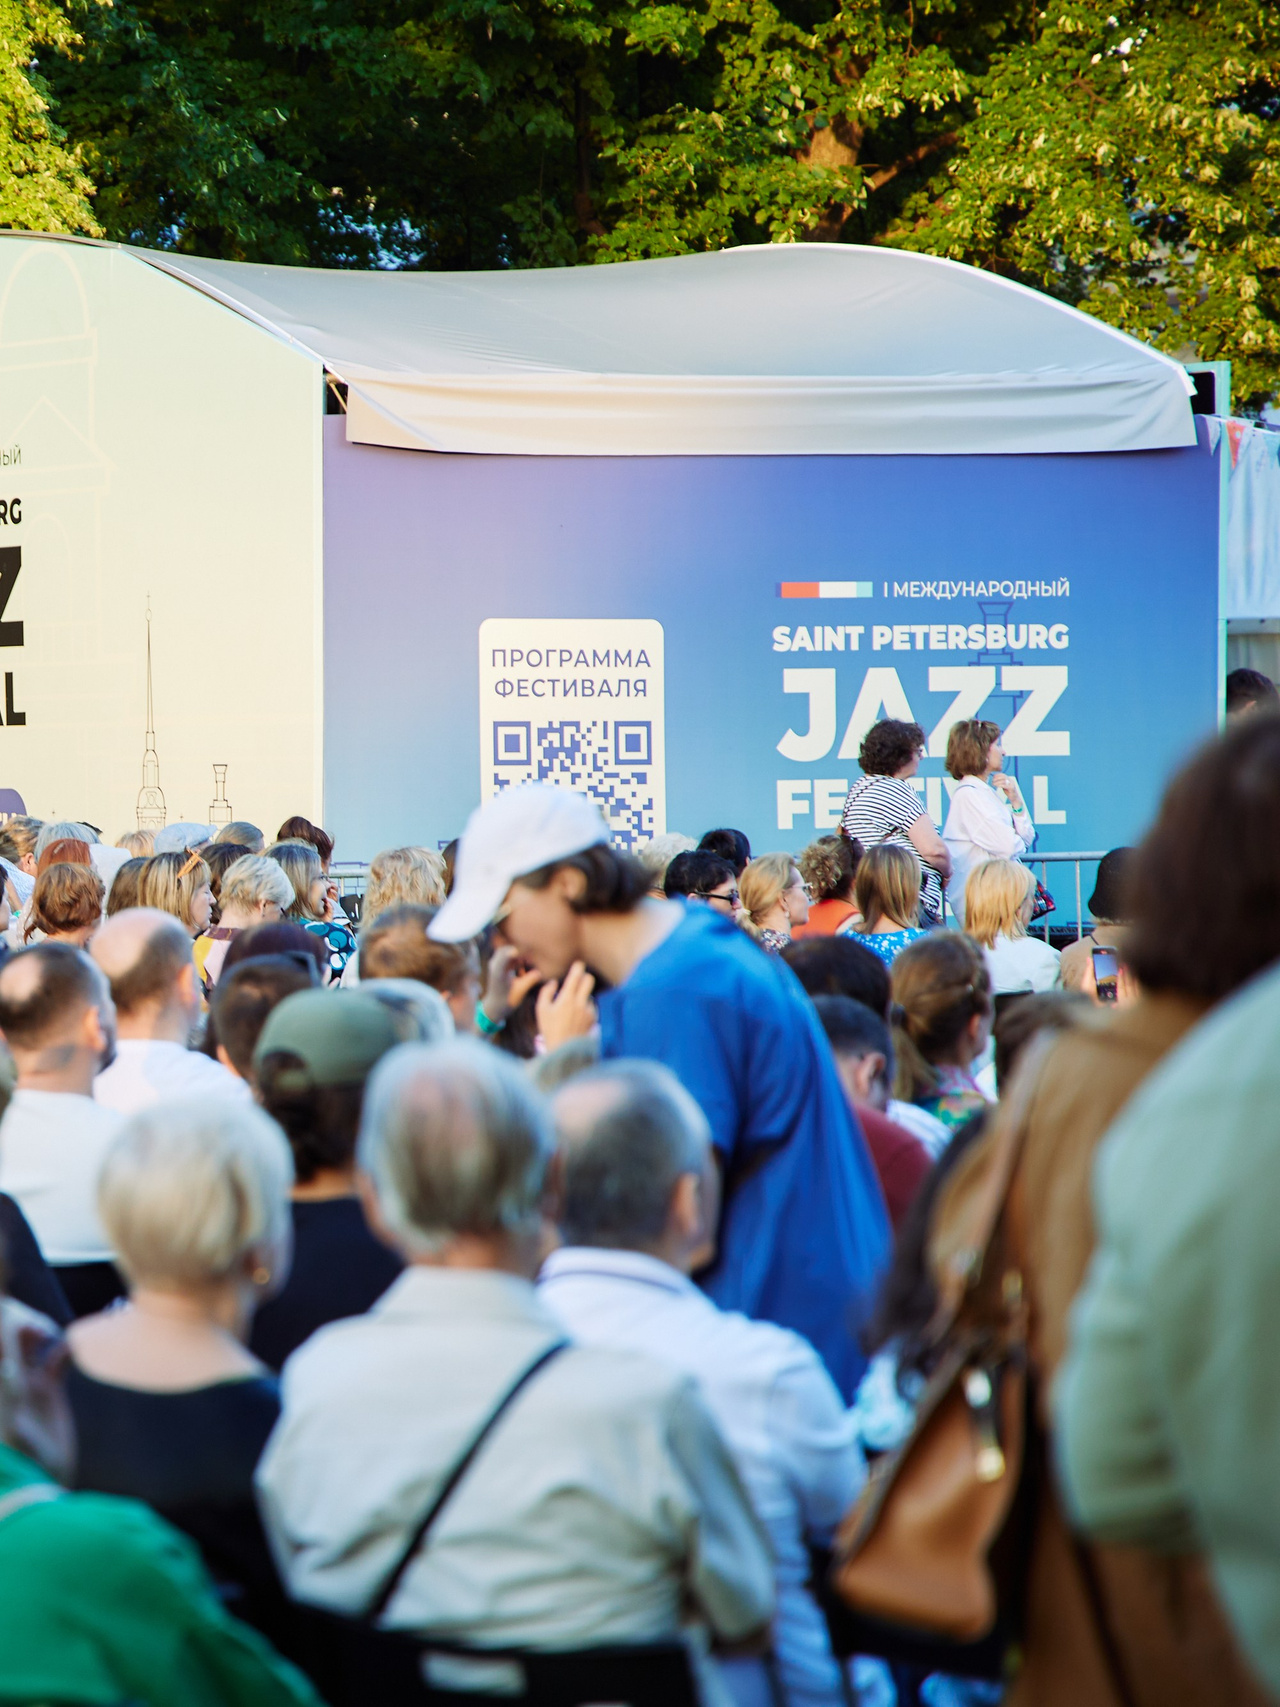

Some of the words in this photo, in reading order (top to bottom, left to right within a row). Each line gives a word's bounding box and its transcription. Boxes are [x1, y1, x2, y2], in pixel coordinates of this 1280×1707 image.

[893, 577, 1070, 600] МЕЖДУНАРОДНЫЙ
[772, 625, 865, 652] SAINT
[872, 623, 1070, 650] PETERSBURG
[491, 648, 652, 668] ПРОГРАММА
[493, 678, 648, 698] ФЕСТИВАЛЯ
[776, 665, 1071, 762] JAZZ
[776, 775, 1067, 829] FEIL
